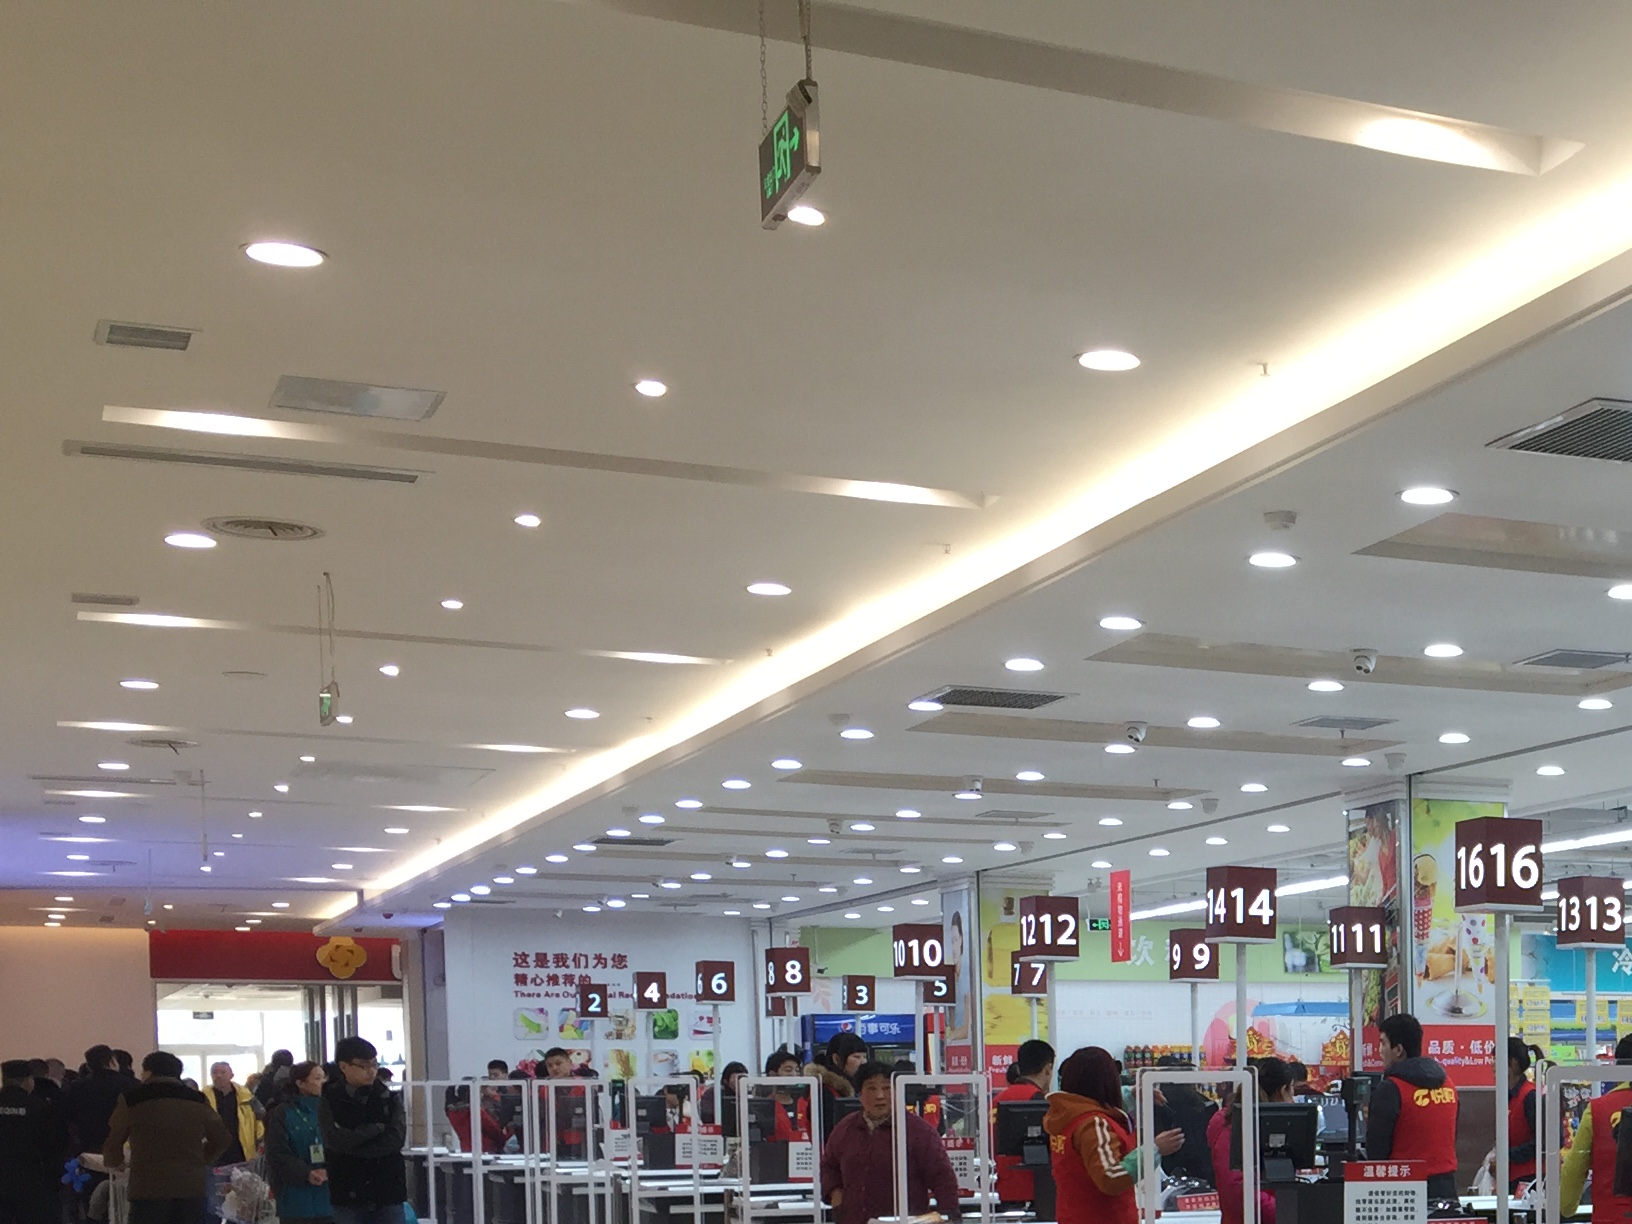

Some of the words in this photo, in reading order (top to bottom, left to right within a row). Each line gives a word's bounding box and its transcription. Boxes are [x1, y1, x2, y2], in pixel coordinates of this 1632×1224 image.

[1457, 843, 1485, 890] 16
[1489, 843, 1540, 889] 16
[1206, 887, 1227, 925] 14
[1230, 887, 1275, 925] 14
[1558, 896, 1581, 932] 13
[1585, 896, 1622, 932] 13
[1020, 914, 1036, 946] 12
[1039, 914, 1077, 945] 12
[1331, 923, 1346, 954] 11
[1351, 924, 1382, 953] 11
[512, 951, 629, 969] 这是我们为您
[893, 939, 906, 967] 10
[907, 938, 942, 967] 10
[1172, 943, 1181, 970] 9
[1192, 943, 1211, 970] 9
[711, 972, 728, 995] 6
[767, 961, 775, 986] 8
[785, 960, 803, 984] 8
[1030, 963, 1047, 986] 7
[562, 990, 577, 998] Ou
[643, 981, 661, 1003] 4
[855, 985, 869, 1006] 3
[933, 979, 948, 997] 5
[587, 993, 602, 1012] 2
[1363, 1164, 1412, 1178] 温馨提示
